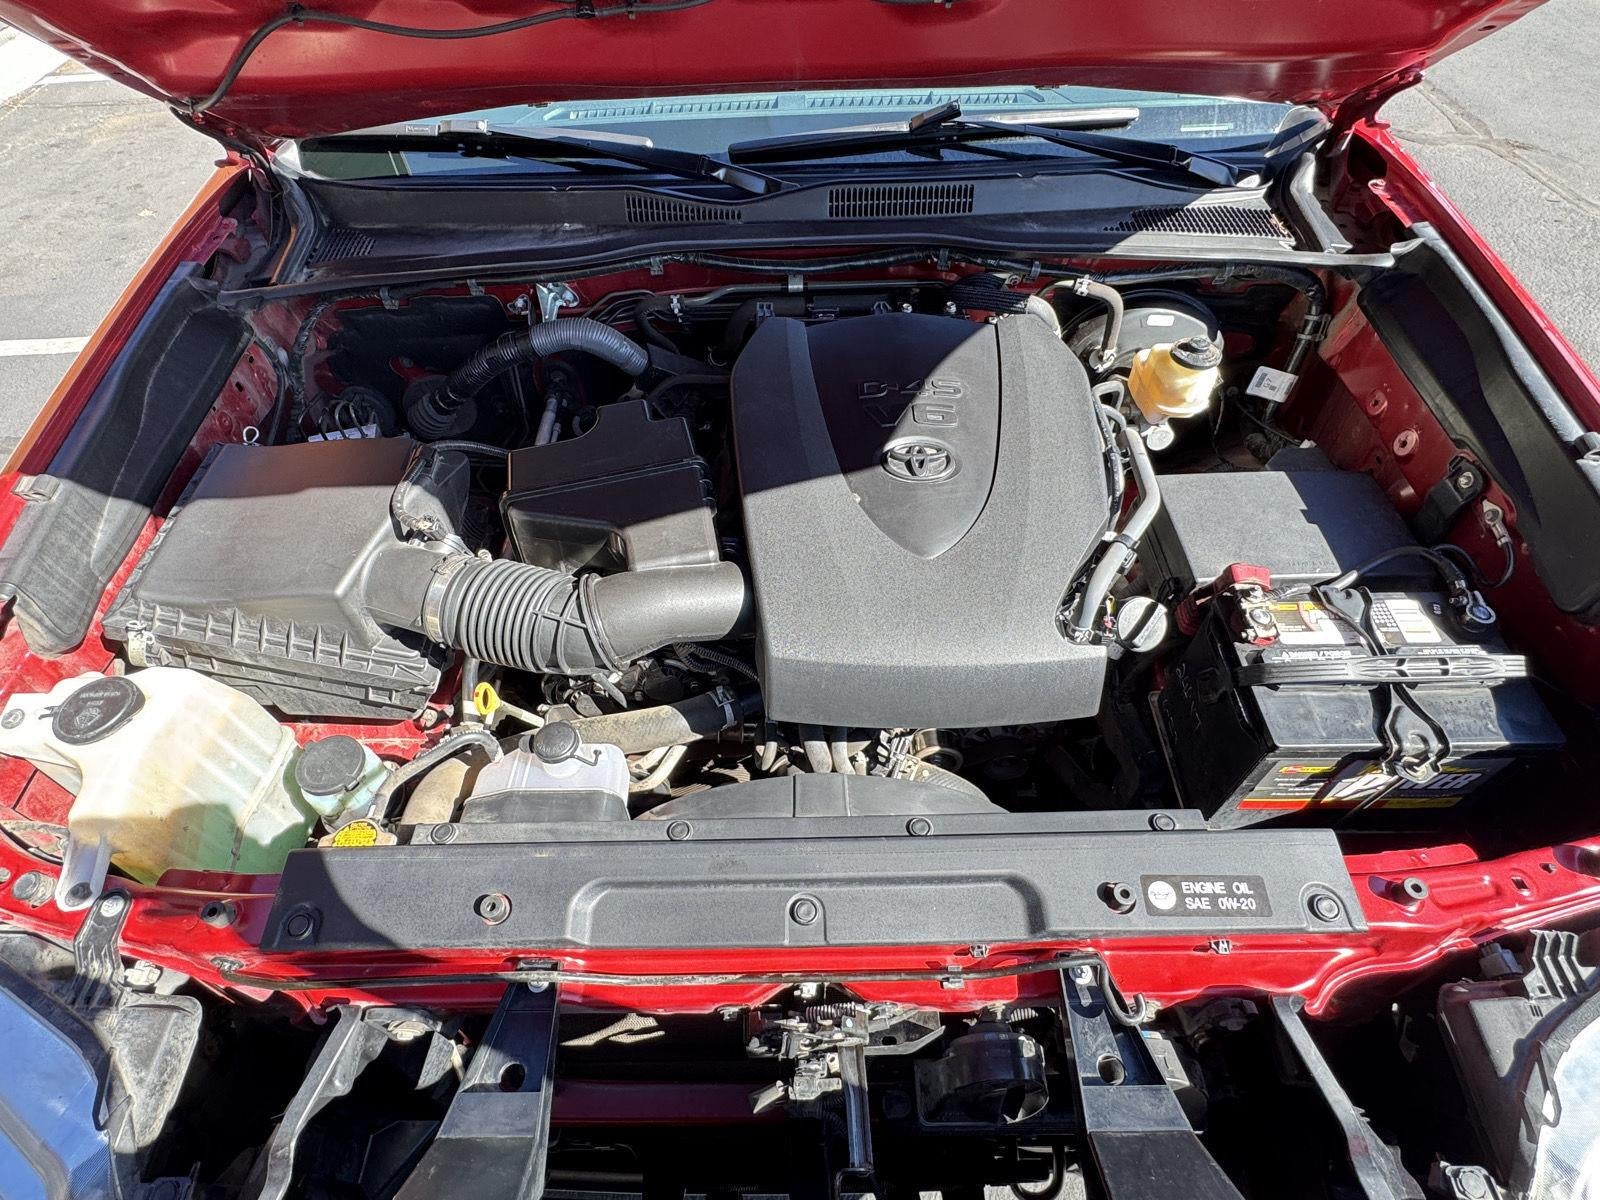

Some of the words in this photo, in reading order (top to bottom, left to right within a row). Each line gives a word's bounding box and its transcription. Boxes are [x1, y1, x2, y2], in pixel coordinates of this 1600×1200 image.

[863, 401, 959, 428] V6
[1181, 881, 1226, 894] ENGINE
[1232, 881, 1253, 894] OIL
[1185, 897, 1211, 909] SAE
[1218, 896, 1256, 910] 0W-20
